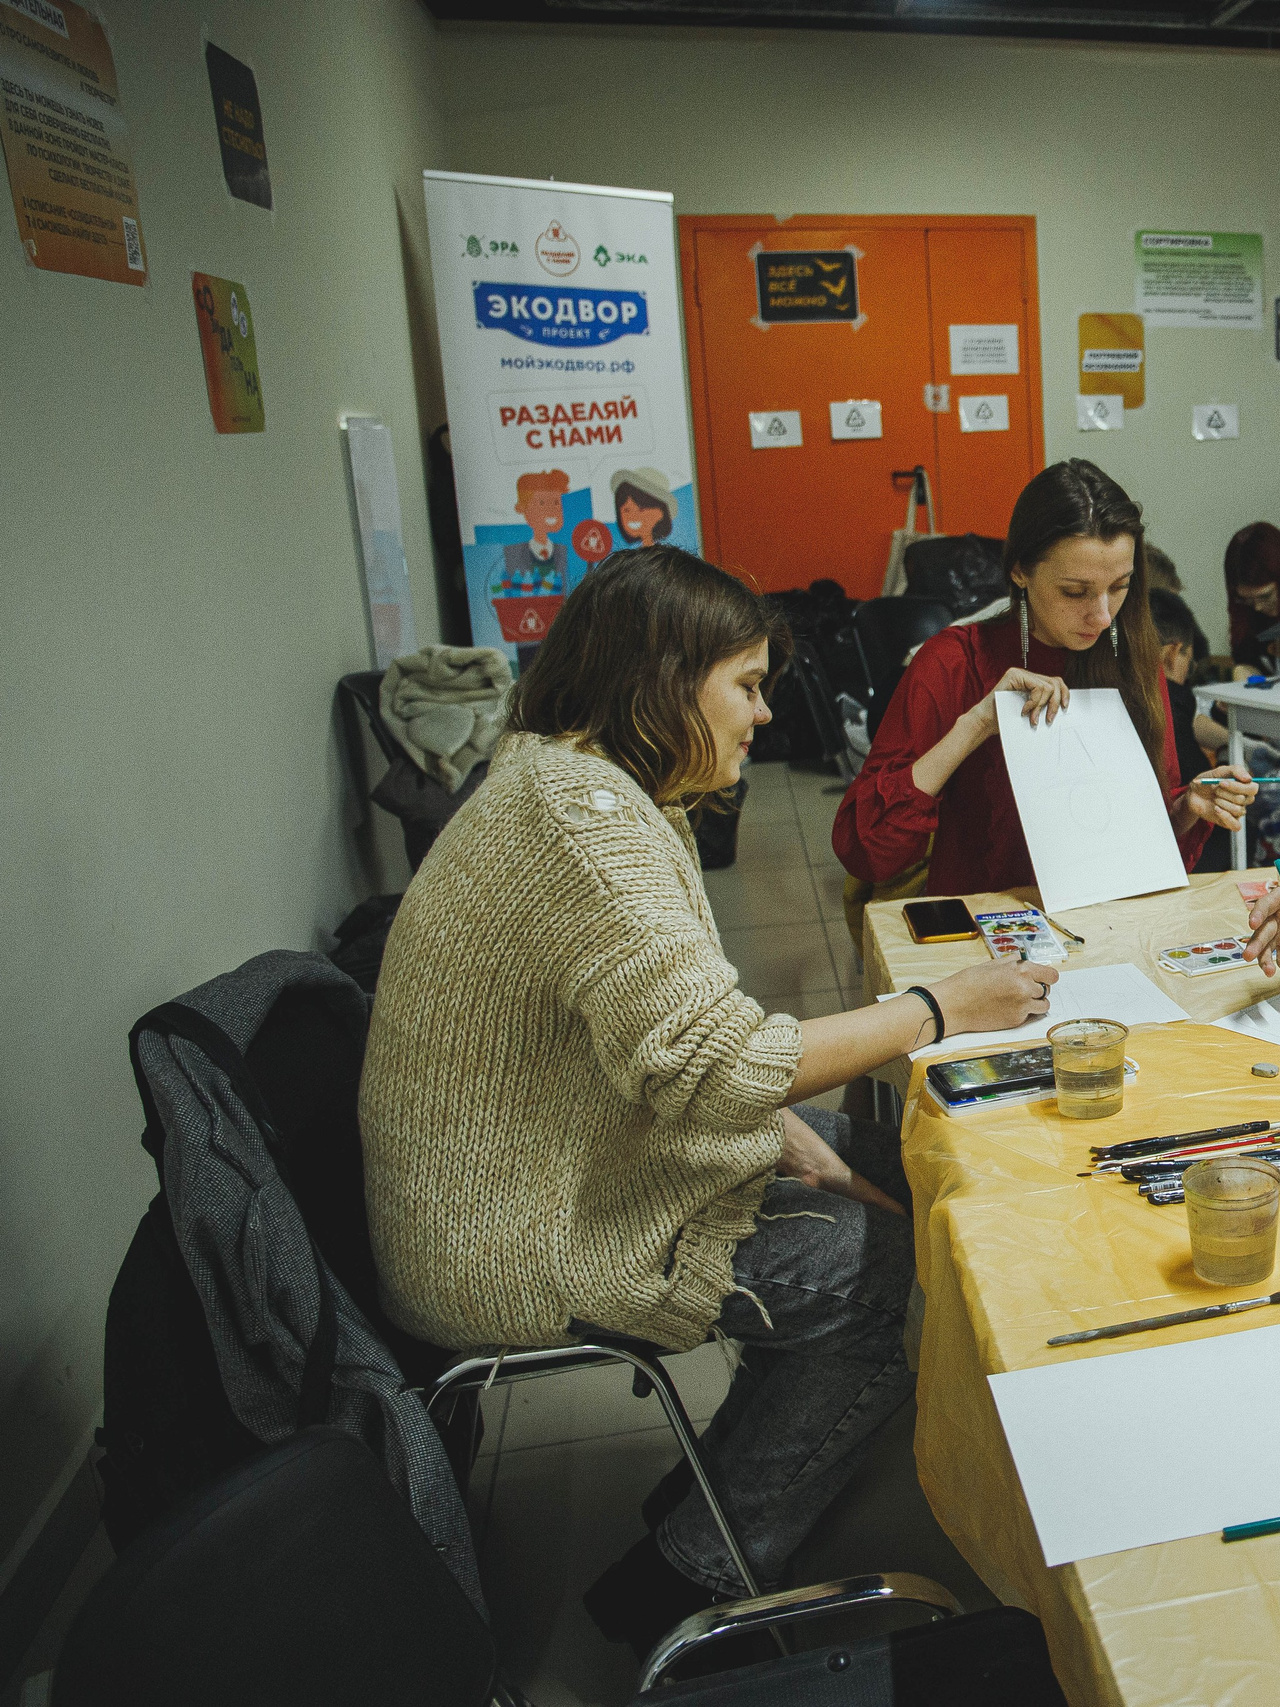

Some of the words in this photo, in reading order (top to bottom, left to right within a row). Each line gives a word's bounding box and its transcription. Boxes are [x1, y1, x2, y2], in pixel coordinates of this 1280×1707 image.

[489, 240, 519, 254] ЭРА
[615, 252, 648, 264] ЭКА
[487, 293, 638, 325] ЭКОДВОР
[542, 328, 591, 340] ПРОЕКТ
[500, 355, 635, 374] мойэкодвор.рф
[499, 395, 638, 427] РАЗДЕЛЯЙ
[525, 430, 543, 449] С
[549, 425, 623, 449] НАМИ
